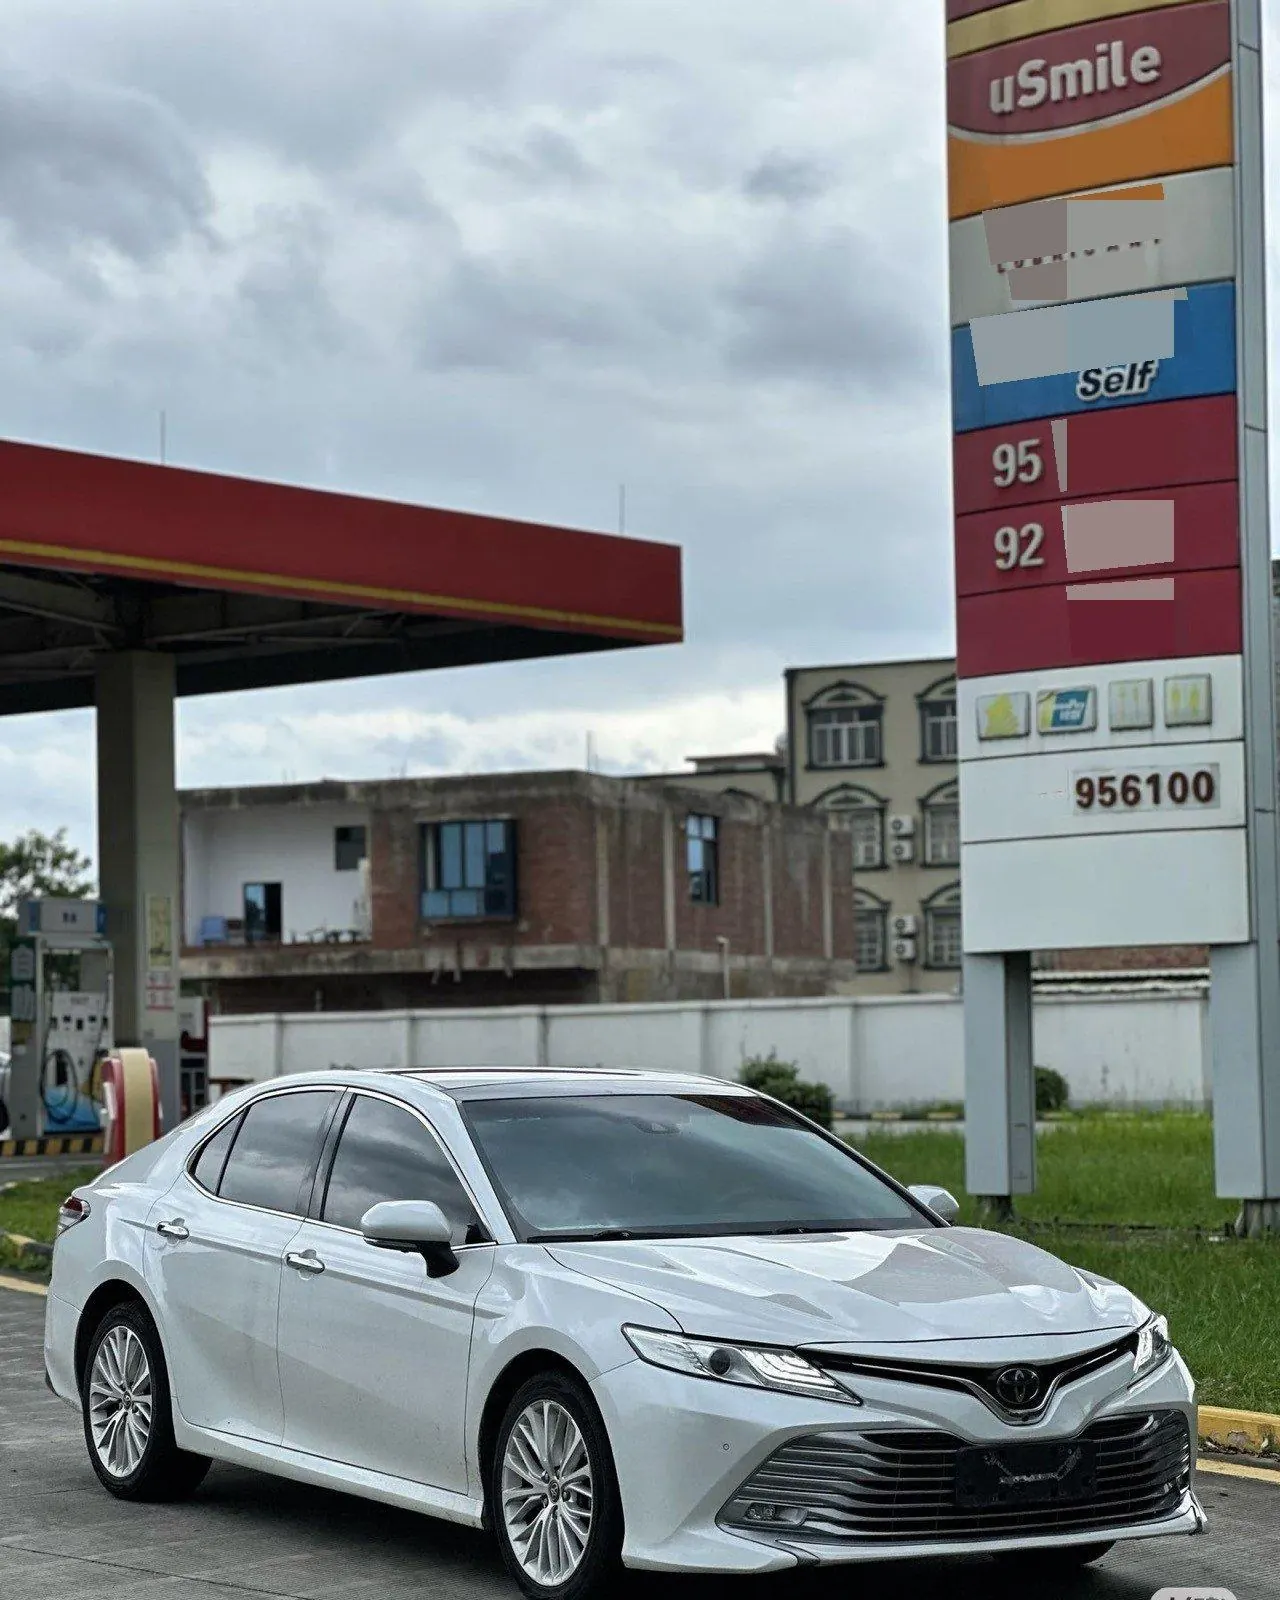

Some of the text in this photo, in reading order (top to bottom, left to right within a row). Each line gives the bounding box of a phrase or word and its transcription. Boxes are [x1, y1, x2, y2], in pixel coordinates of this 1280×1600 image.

[989, 40, 1162, 114] uSmile
[1077, 360, 1157, 400] Self
[992, 438, 1043, 488] 95
[993, 522, 1045, 570] 92
[1075, 770, 1215, 809] 956100
